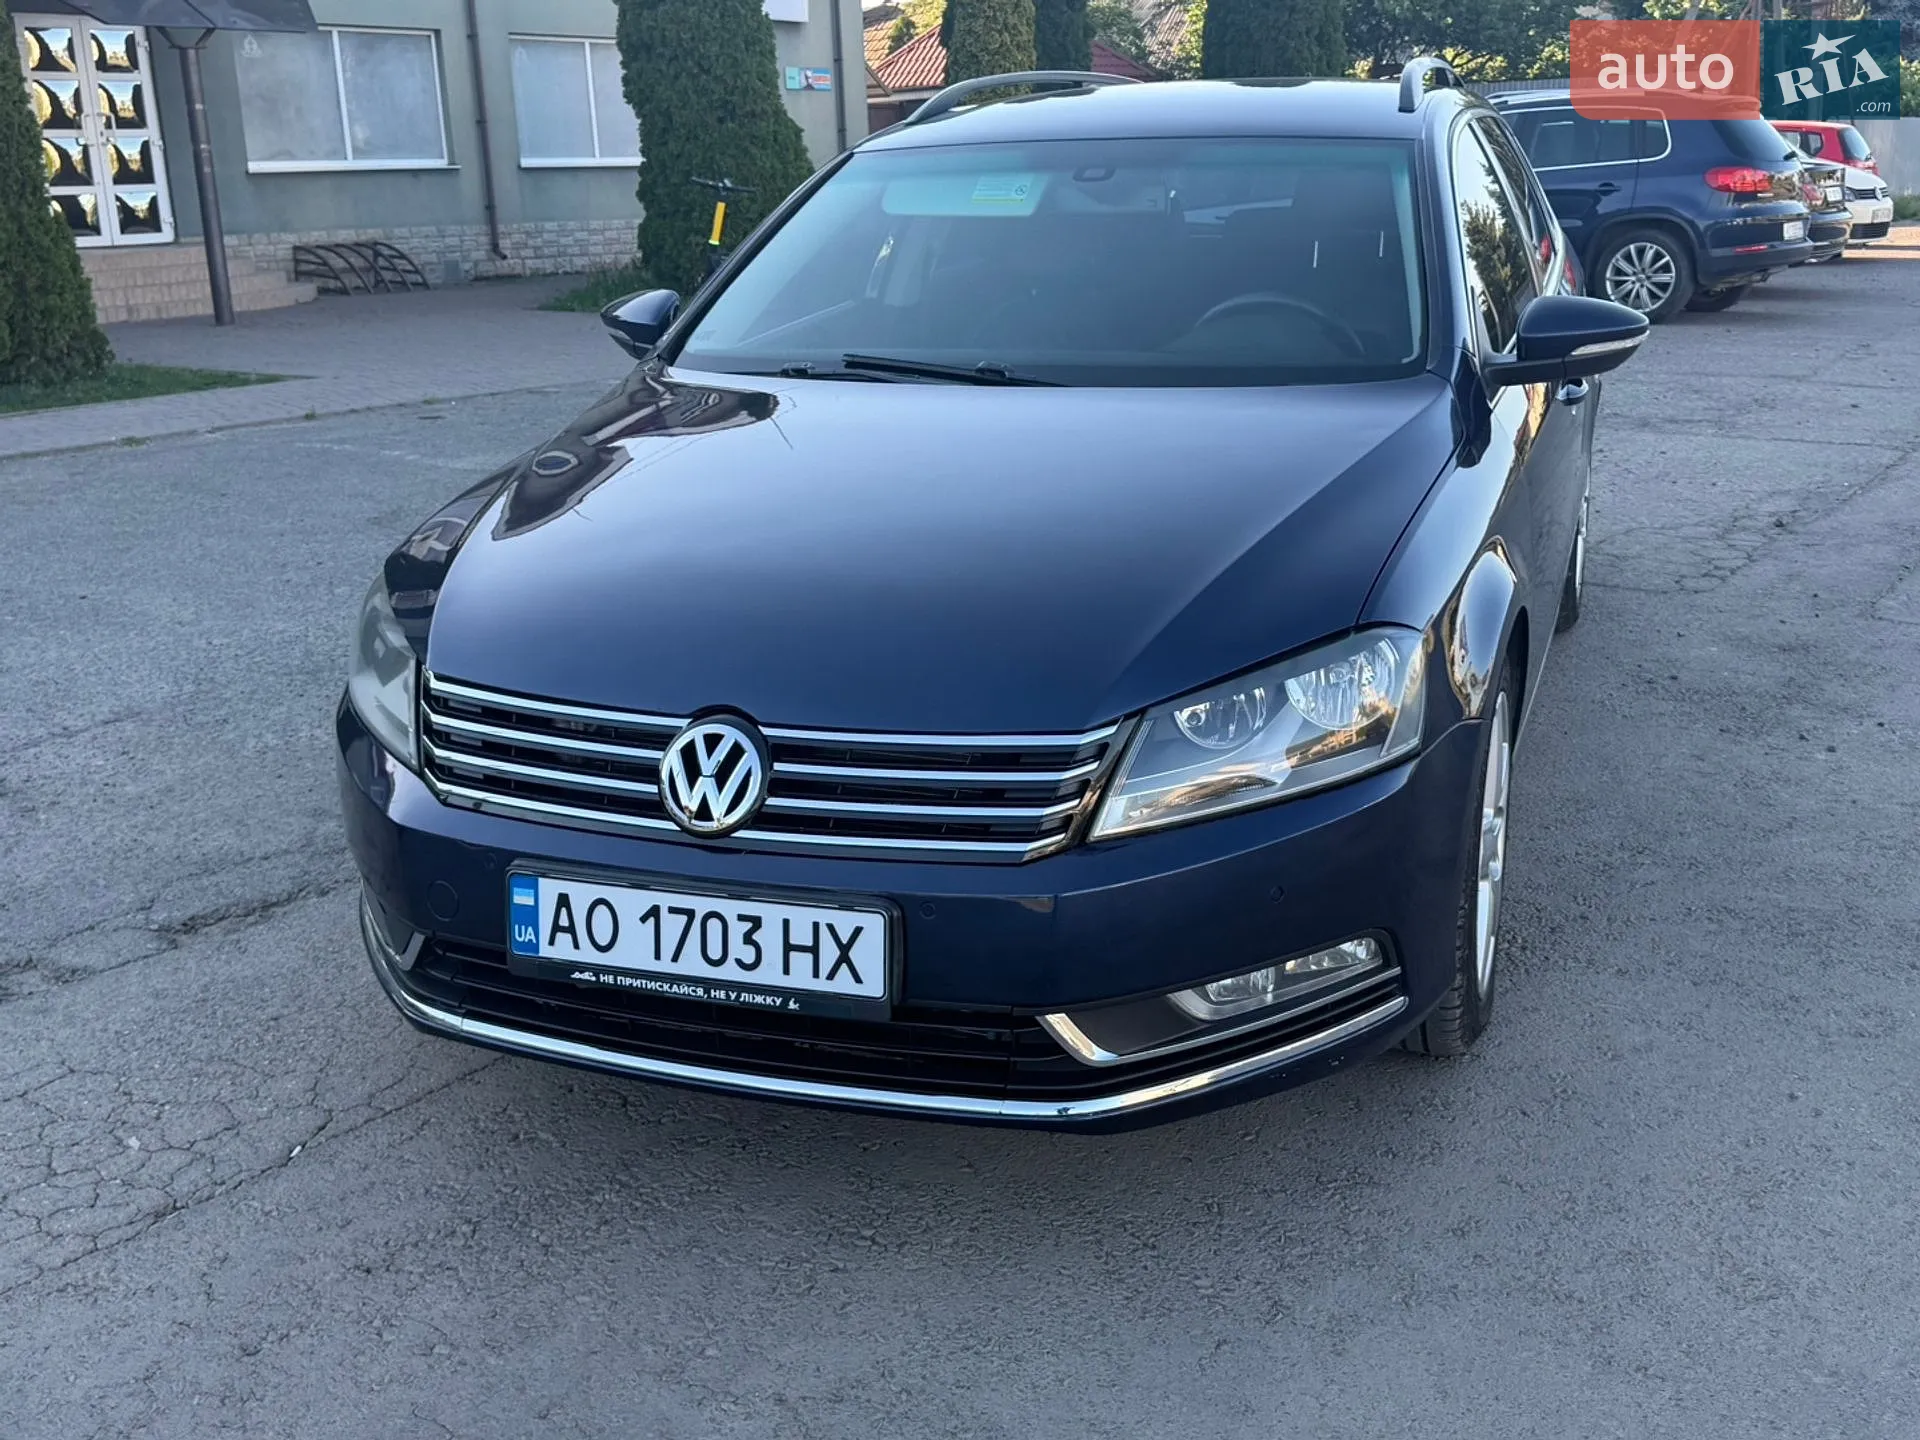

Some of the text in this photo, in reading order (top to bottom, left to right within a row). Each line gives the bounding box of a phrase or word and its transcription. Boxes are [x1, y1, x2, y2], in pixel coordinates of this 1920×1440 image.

[515, 924, 537, 944] UA
[547, 892, 865, 984] AO 1703 HX
[600, 974, 783, 1007] НЕ ПРИТИСКАЙСЯ, НЕ У ЛІЖКУ
